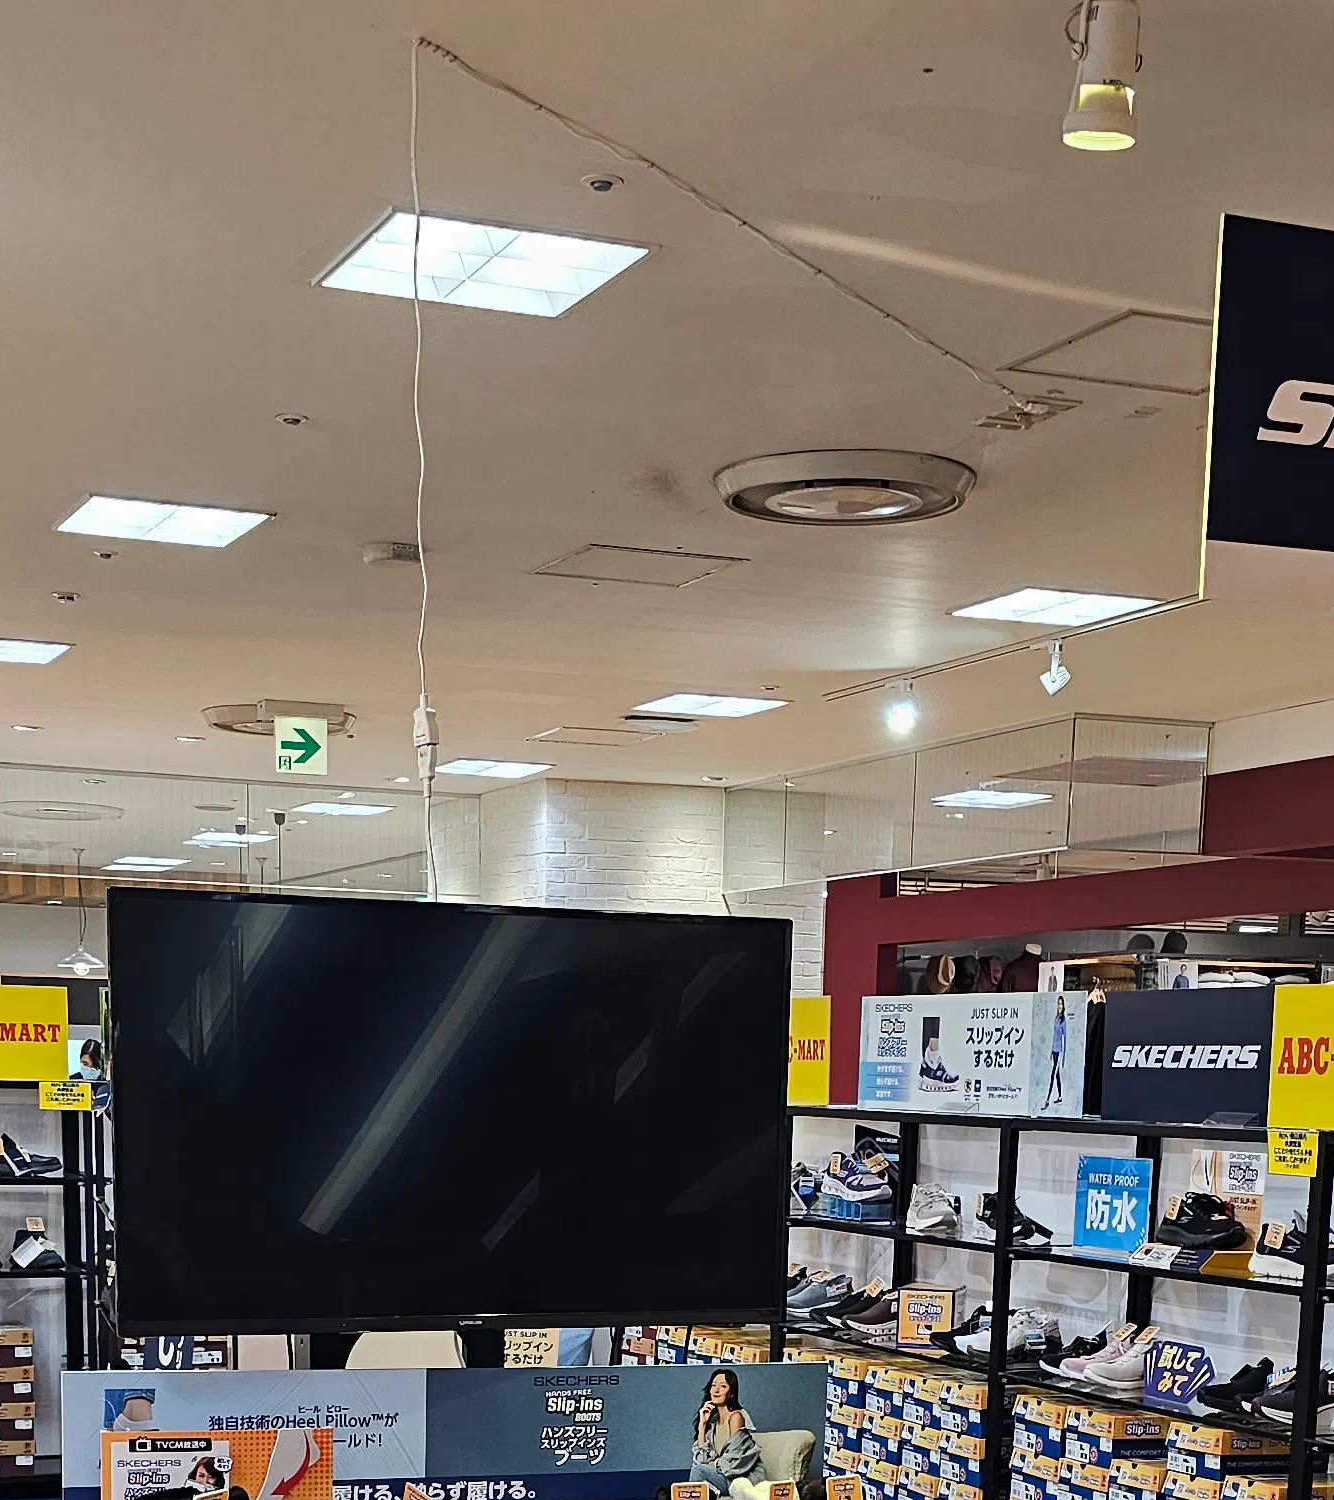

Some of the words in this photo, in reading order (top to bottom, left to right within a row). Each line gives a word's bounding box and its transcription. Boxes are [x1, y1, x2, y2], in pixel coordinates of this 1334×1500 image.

[875, 1004, 913, 1013] SKECHERS
[971, 1009, 989, 1020] JUST
[991, 1009, 1008, 1019] SLIP
[1010, 1008, 1019, 1018] IN
[966, 1026, 1025, 1045] スリップイン
[974, 1050, 1014, 1068] するだけ
[1111, 1045, 1261, 1069] SKECHERS
[1089, 1172, 1113, 1184] WATER
[1114, 1174, 1140, 1185] PROOF
[1085, 1188, 1138, 1233] 防水
[908, 1303, 943, 1315] Slip-ins
[1157, 1344, 1204, 1371] 試して
[533, 1375, 620, 1387] SKECHERS
[1159, 1370, 1187, 1396] みて
[545, 1389, 571, 1397] HANDS
[573, 1388, 592, 1396] FREE
[298, 1406, 321, 1414] ヒール
[326, 1405, 350, 1413] ピロー
[547, 1397, 603, 1415] Slip-ins
[208, 1413, 321, 1430] 独自技術のHeel
[575, 1412, 602, 1422] BOOTS
[541, 1425, 608, 1439] ハンズフリー
[1126, 1422, 1161, 1436] Slip-ins
[540, 1437, 607, 1450] スリップインズ
[117, 1459, 182, 1468] SKECHERS
[554, 1448, 606, 1466] ブーツ
[129, 1473, 170, 1486] Slip-ins
